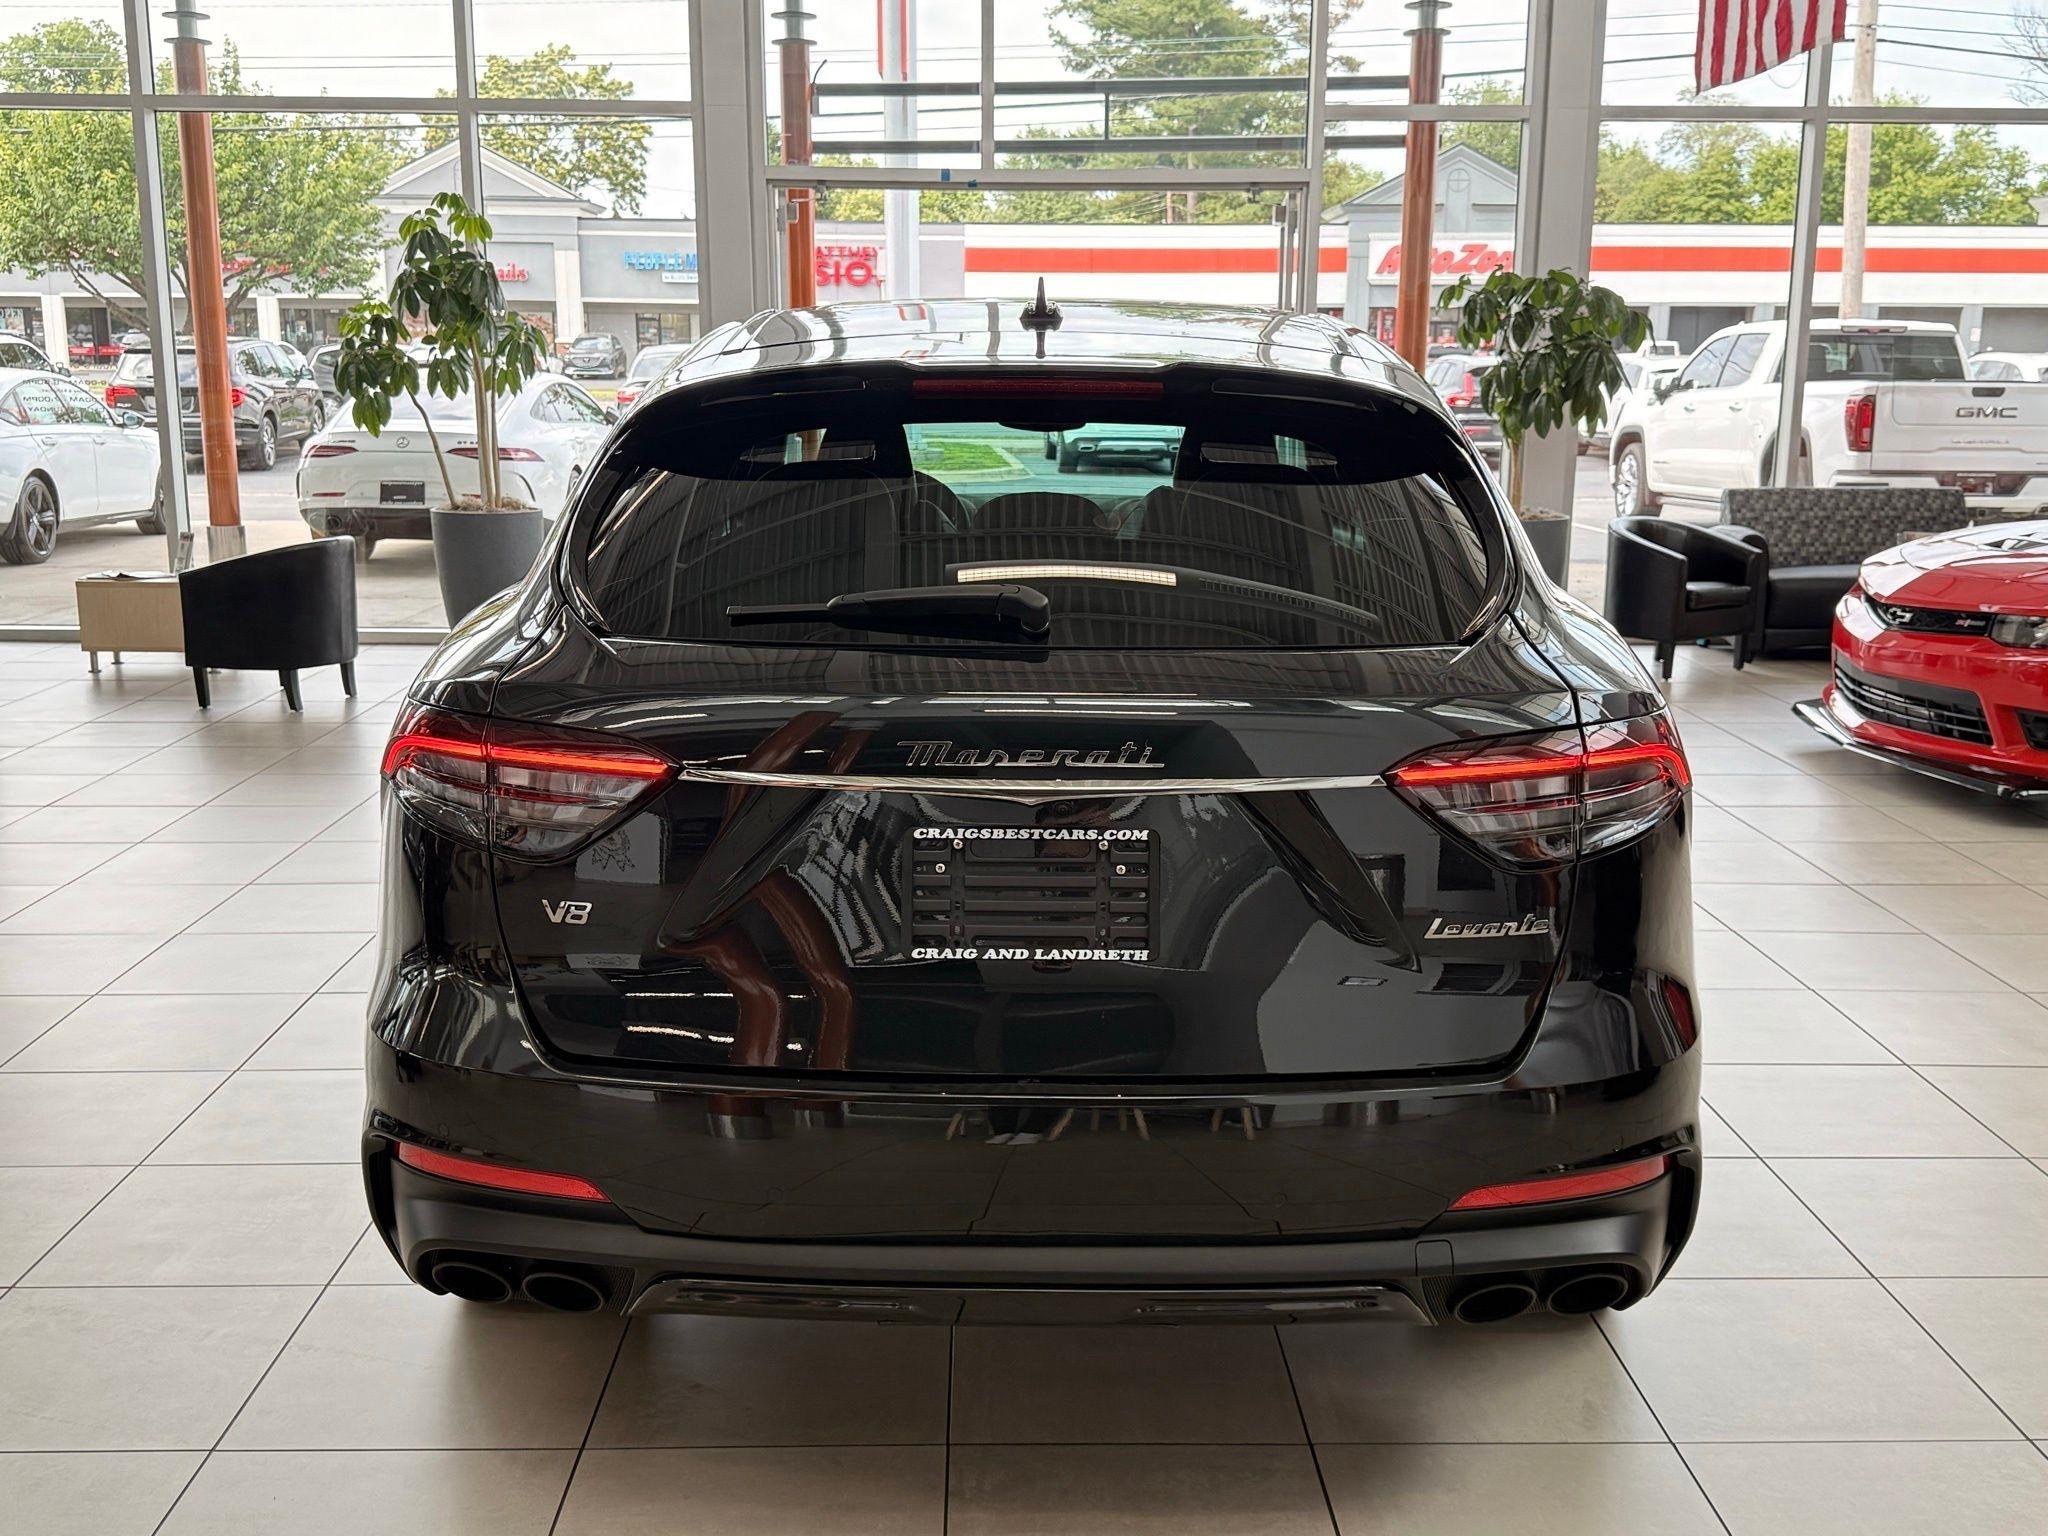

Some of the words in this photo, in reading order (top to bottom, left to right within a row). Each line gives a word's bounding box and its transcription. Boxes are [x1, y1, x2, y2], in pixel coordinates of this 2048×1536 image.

[497, 262, 528, 281] ails
[1376, 244, 1515, 275] AoZon
[816, 261, 881, 288] SIO
[1956, 407, 2018, 419] GMC
[897, 741, 1165, 768] Maserati
[913, 828, 1149, 841] CRAIGSBESTCARS.COM
[542, 900, 593, 925] V8
[1424, 913, 1550, 940] Levante
[911, 948, 978, 960] CRAIG
[982, 949, 1029, 960] AND
[1034, 949, 1150, 961] LANDRETH
